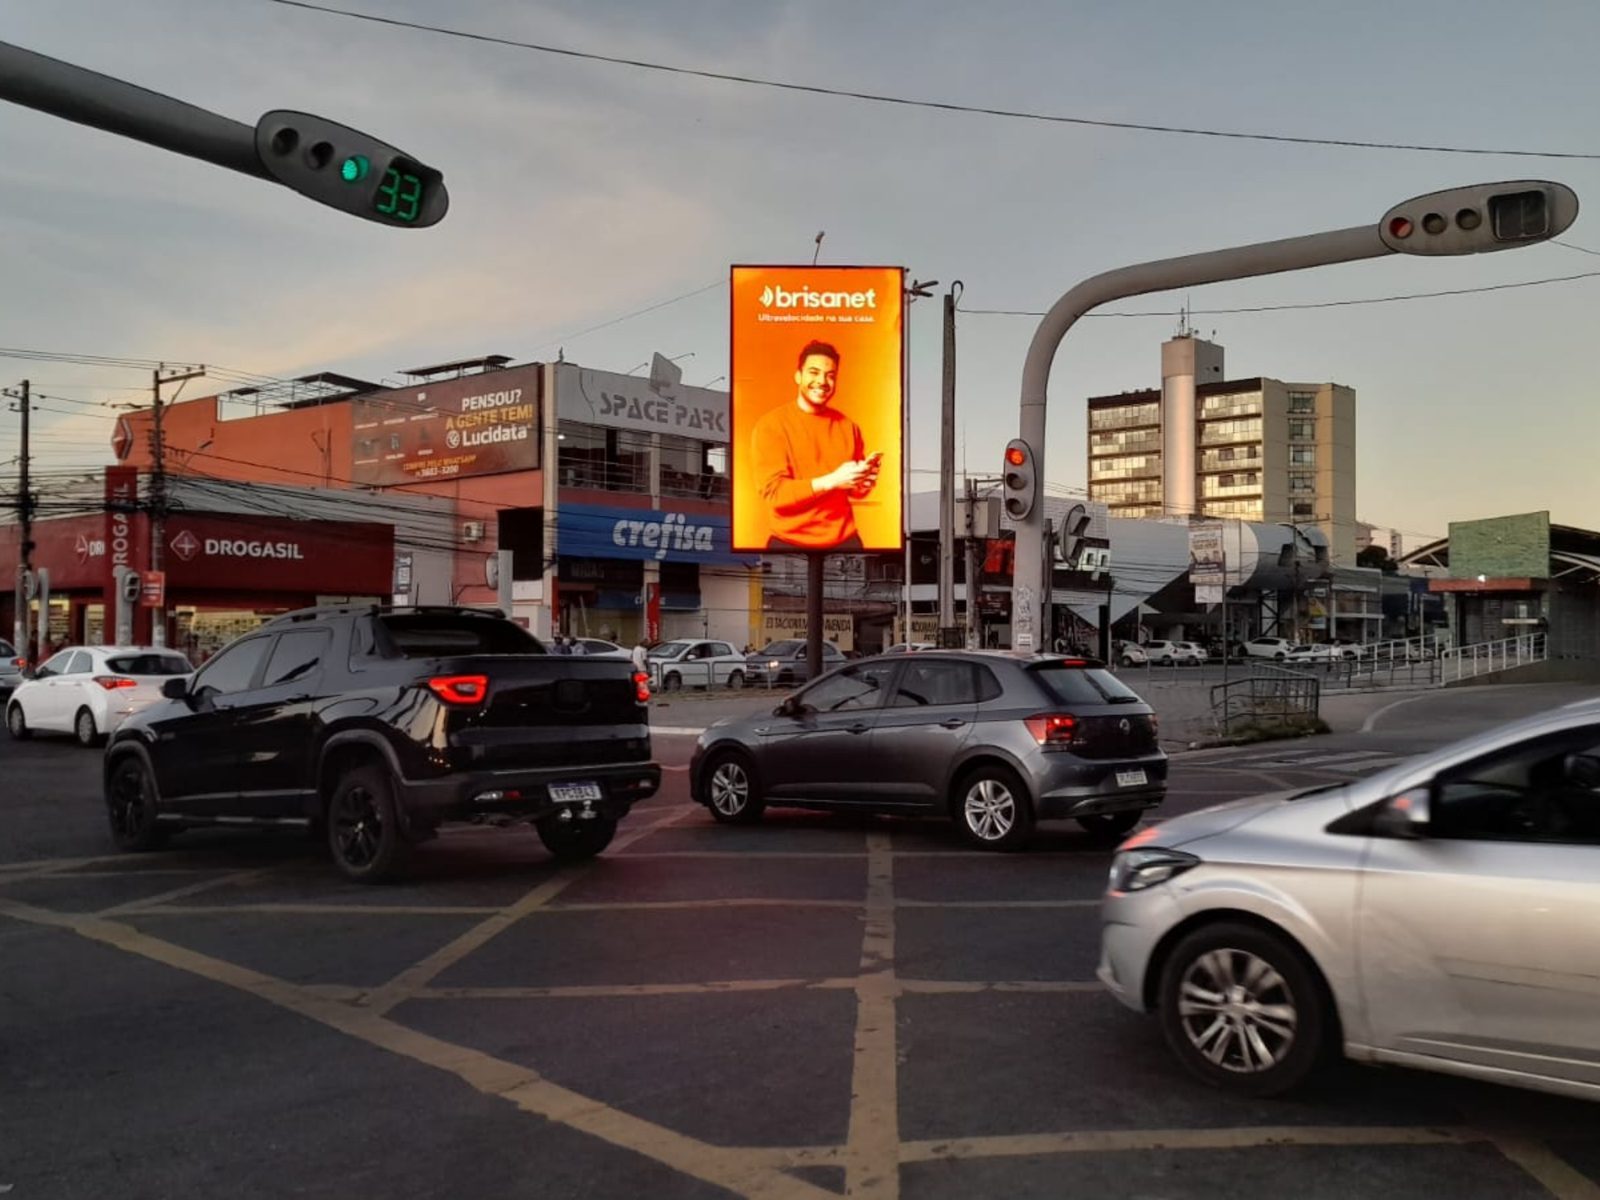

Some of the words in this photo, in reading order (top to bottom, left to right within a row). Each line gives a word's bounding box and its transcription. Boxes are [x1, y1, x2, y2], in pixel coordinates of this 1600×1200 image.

[377, 166, 422, 221] 33
[775, 285, 876, 308] brisanet
[462, 389, 522, 411] PENSOU?
[600, 391, 668, 424] SPACE
[676, 405, 725, 432] PARK
[445, 417, 454, 430] A
[456, 409, 498, 428] GENTE
[500, 403, 533, 421] TEM!
[462, 424, 528, 447] Lucidata
[613, 513, 713, 559] crefisa
[204, 539, 304, 559] DROGASIL
